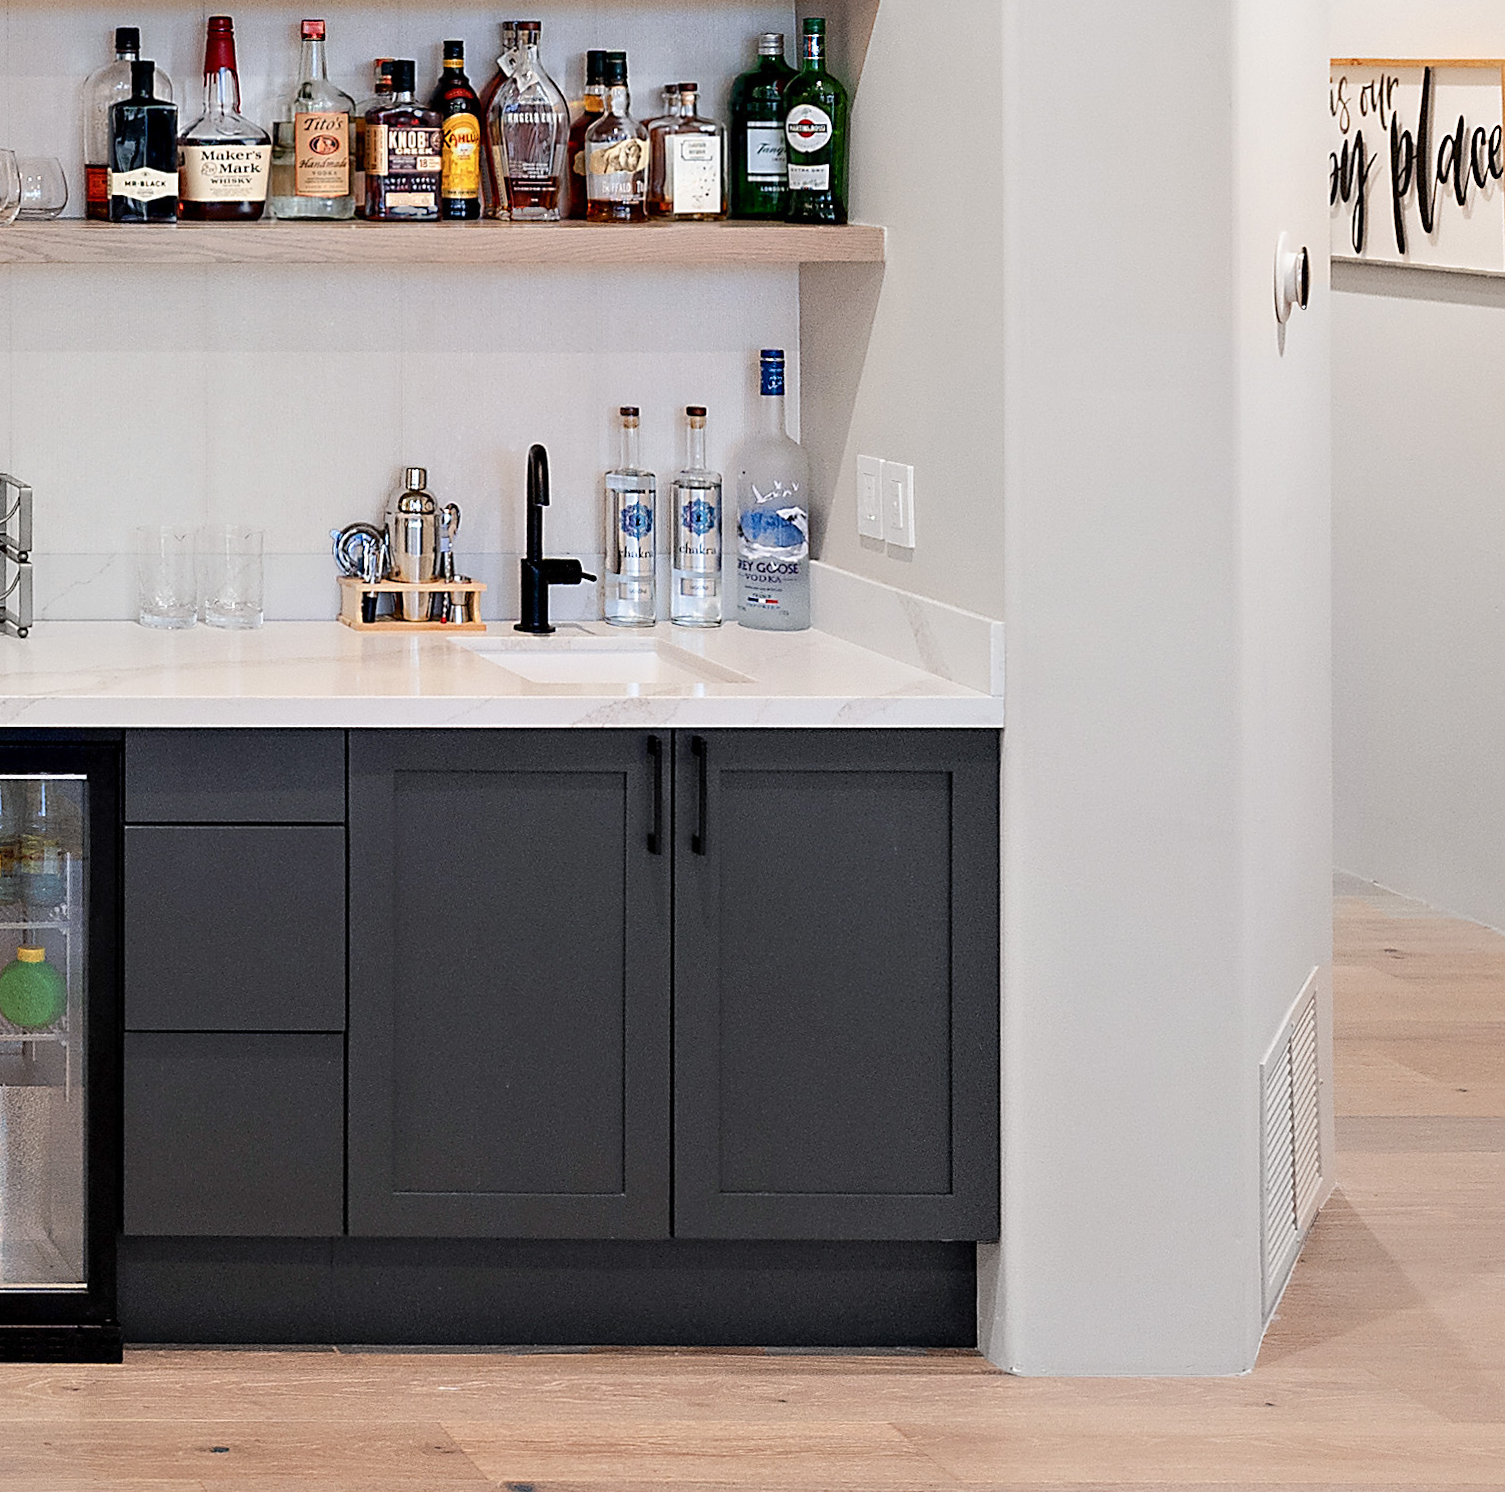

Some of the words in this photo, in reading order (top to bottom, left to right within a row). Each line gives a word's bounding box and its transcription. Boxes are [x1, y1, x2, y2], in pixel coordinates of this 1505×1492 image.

[1359, 73, 1399, 131] our
[303, 116, 344, 131] Tito's
[389, 131, 426, 149] KNOB
[200, 150, 262, 161] Maker's
[1390, 66, 1503, 255] place
[219, 163, 262, 174] Mark
[679, 542, 716, 555] chakra
[756, 561, 799, 575] GOOSE
[744, 573, 782, 583] VODKA
